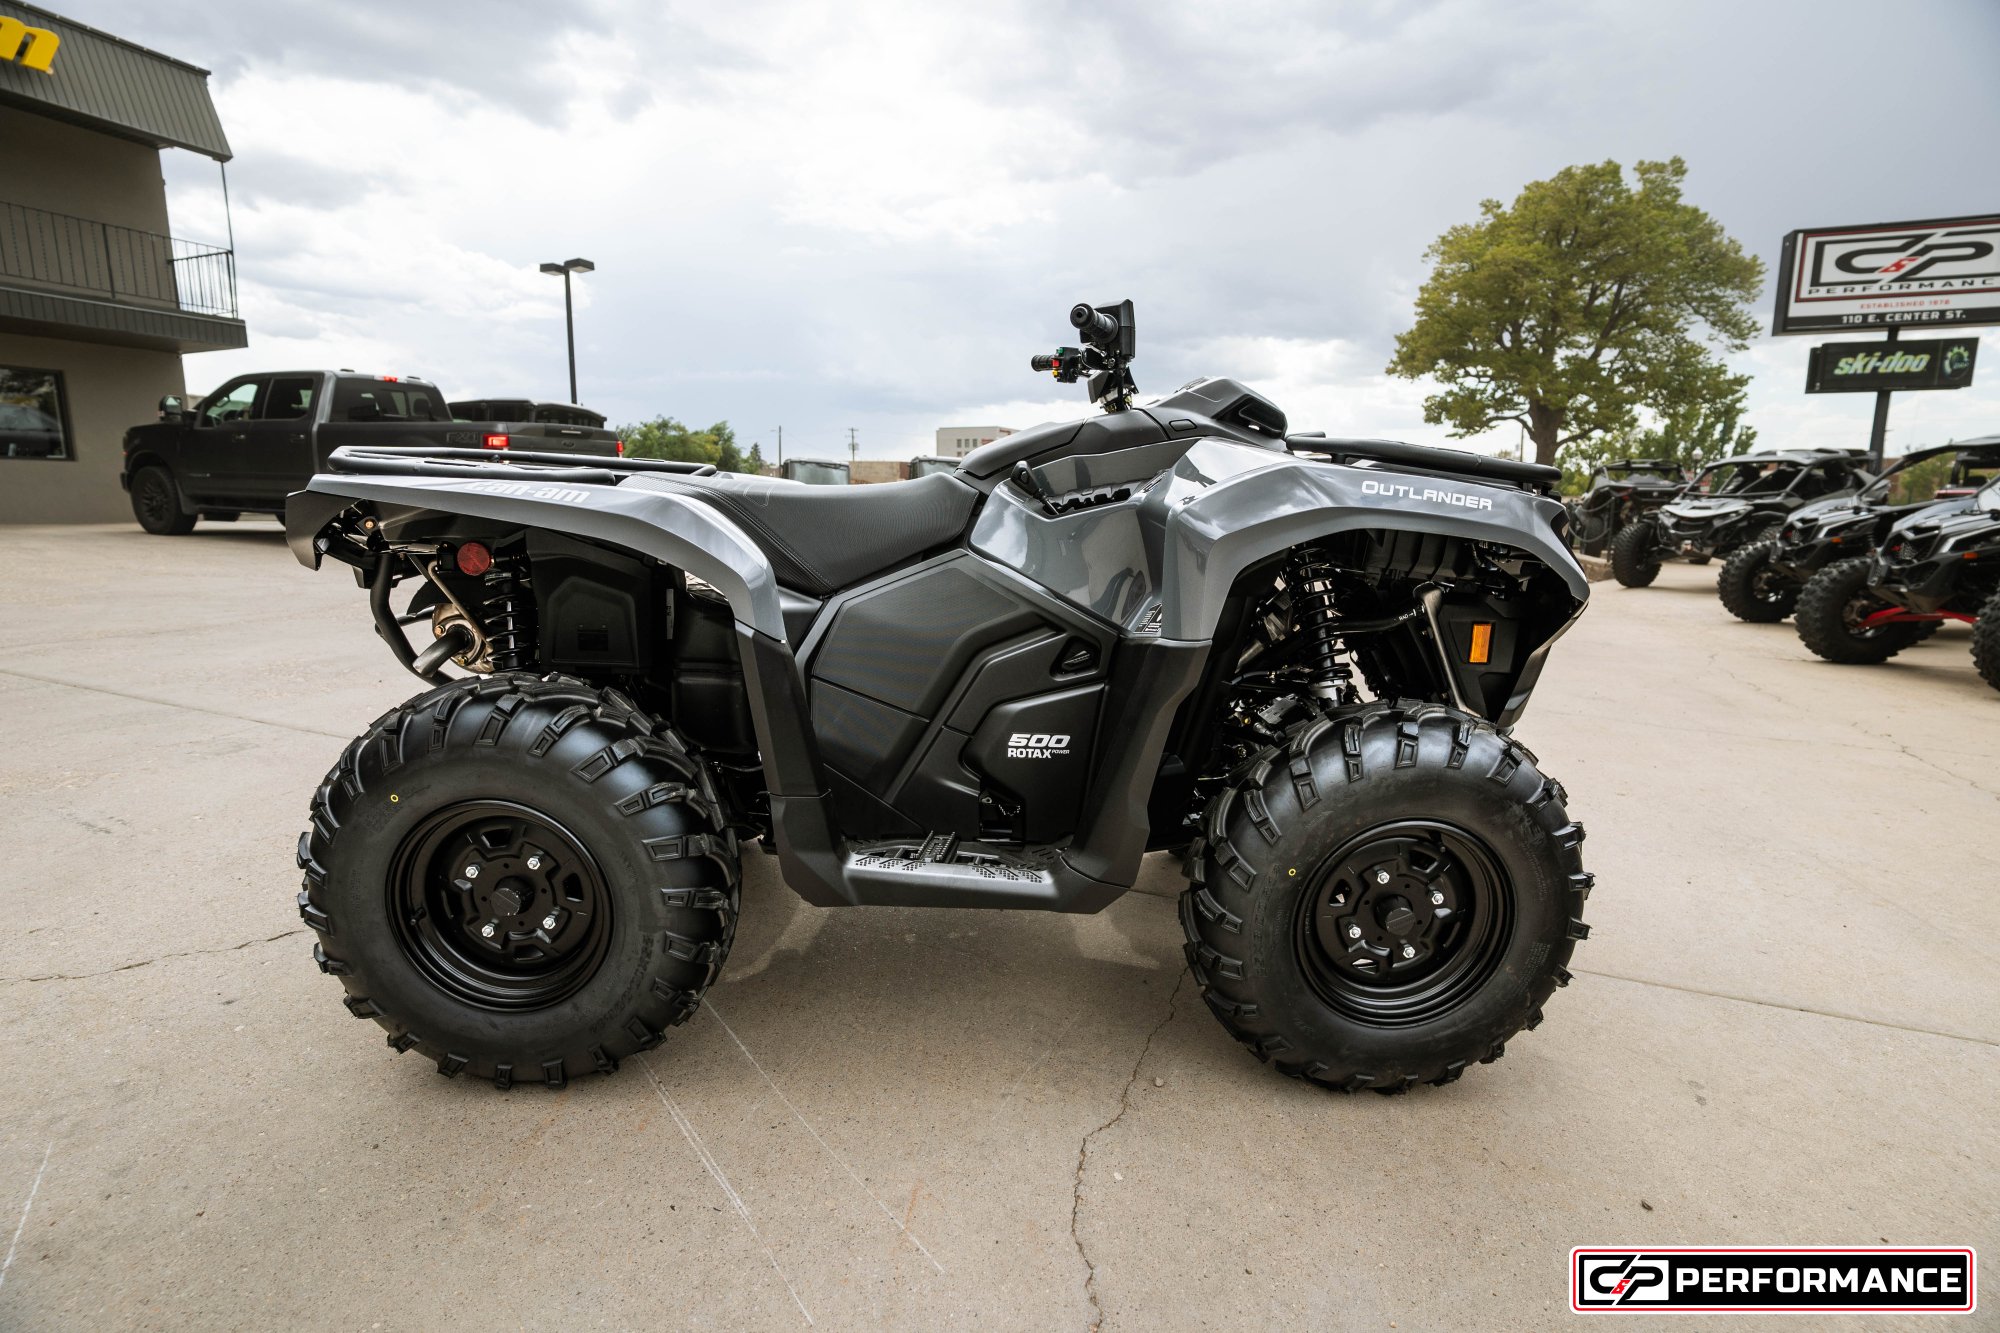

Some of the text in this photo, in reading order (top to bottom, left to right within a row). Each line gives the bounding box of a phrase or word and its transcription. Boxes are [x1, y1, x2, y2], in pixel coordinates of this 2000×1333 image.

[1860, 300, 1925, 310] ESTABLISHED
[1842, 309, 1967, 324] 110 E. CENTER ST.
[1361, 480, 1493, 511] OUTLANDER
[1008, 733, 1071, 748] 500
[1007, 747, 1052, 759] ROTAX
